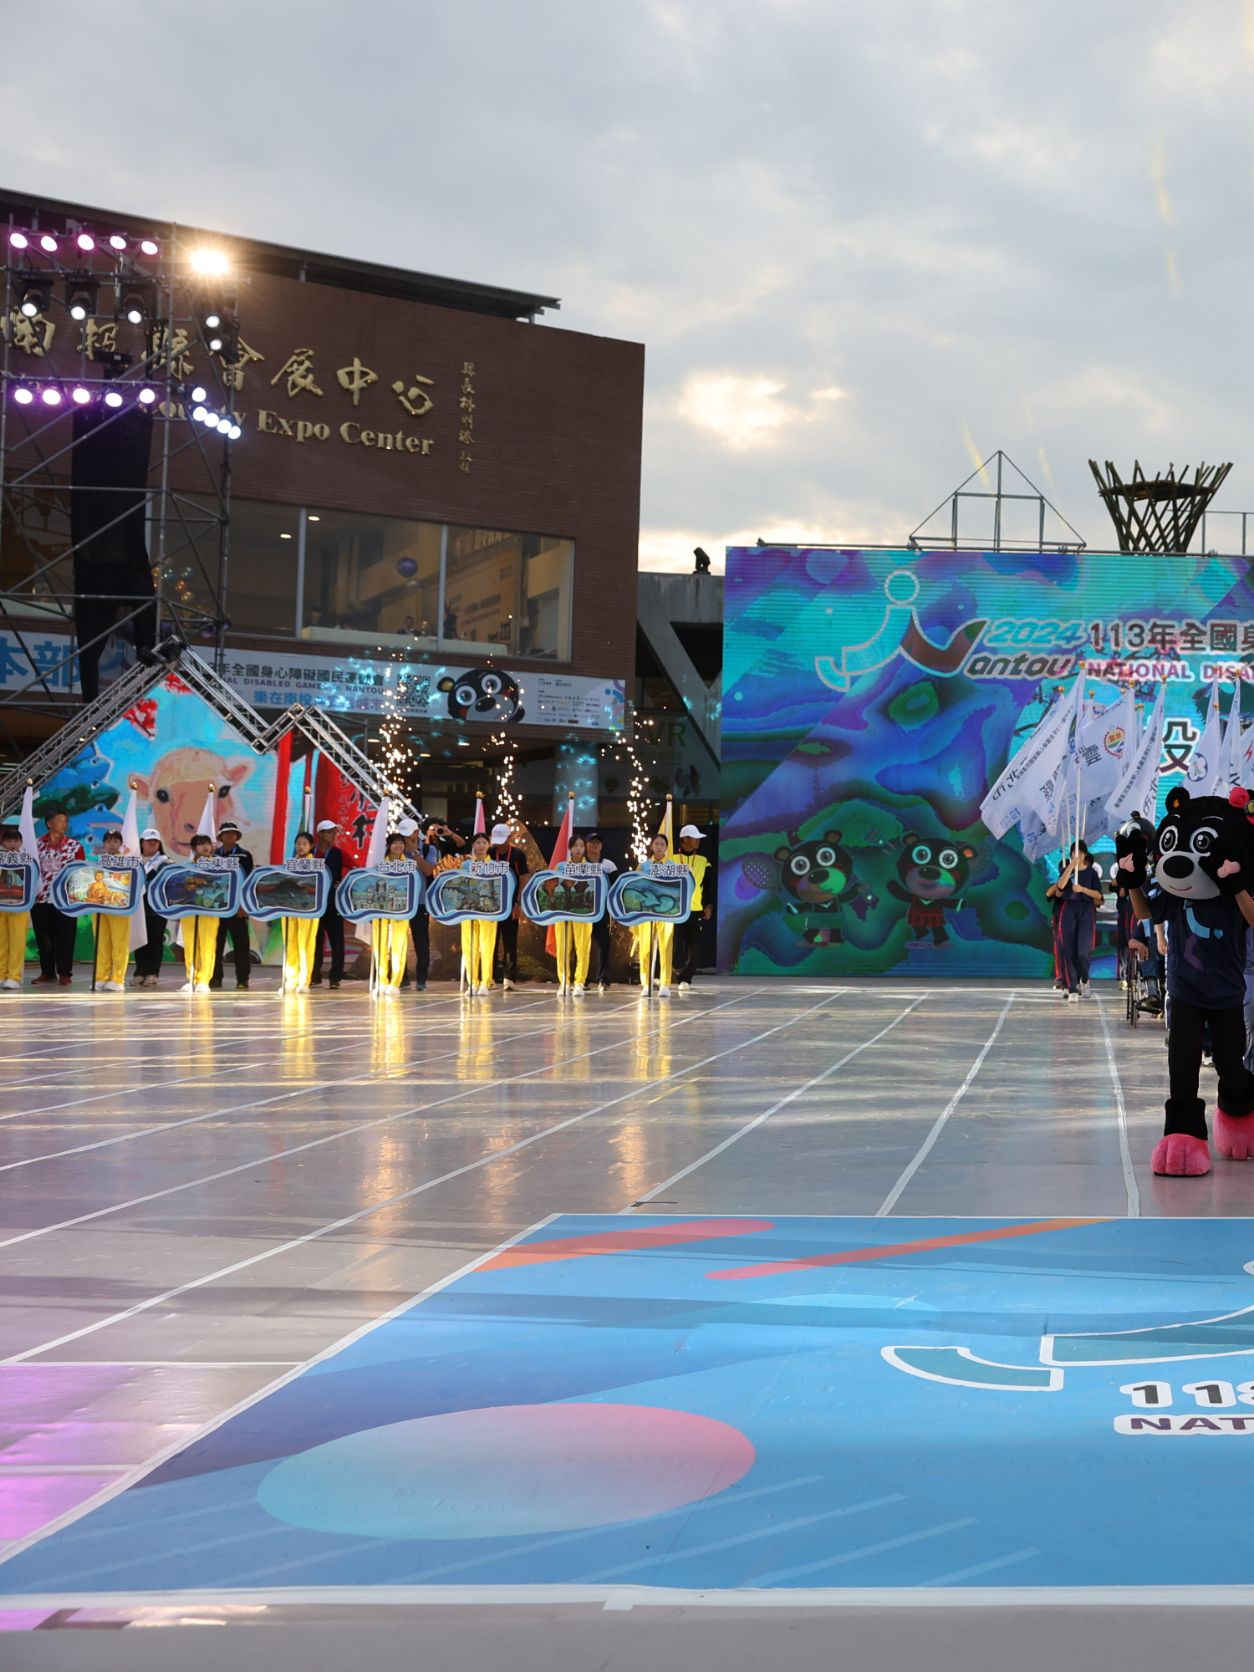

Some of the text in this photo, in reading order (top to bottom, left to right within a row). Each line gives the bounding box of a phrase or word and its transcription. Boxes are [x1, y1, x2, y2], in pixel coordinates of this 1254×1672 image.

[257, 408, 331, 443] Expo
[339, 421, 435, 455] Center
[989, 620, 1085, 645] 2024
[1088, 663, 1191, 679] NATIONAL
[100, 855, 139, 868] 高雄市
[200, 857, 239, 870] 台東縣
[287, 859, 325, 872] 宜蘭縣
[379, 860, 416, 873] 台北市
[471, 863, 509, 875] 新竹市
[566, 864, 602, 876] 苗栗縣
[651, 865, 688, 877] 澎湖縣
